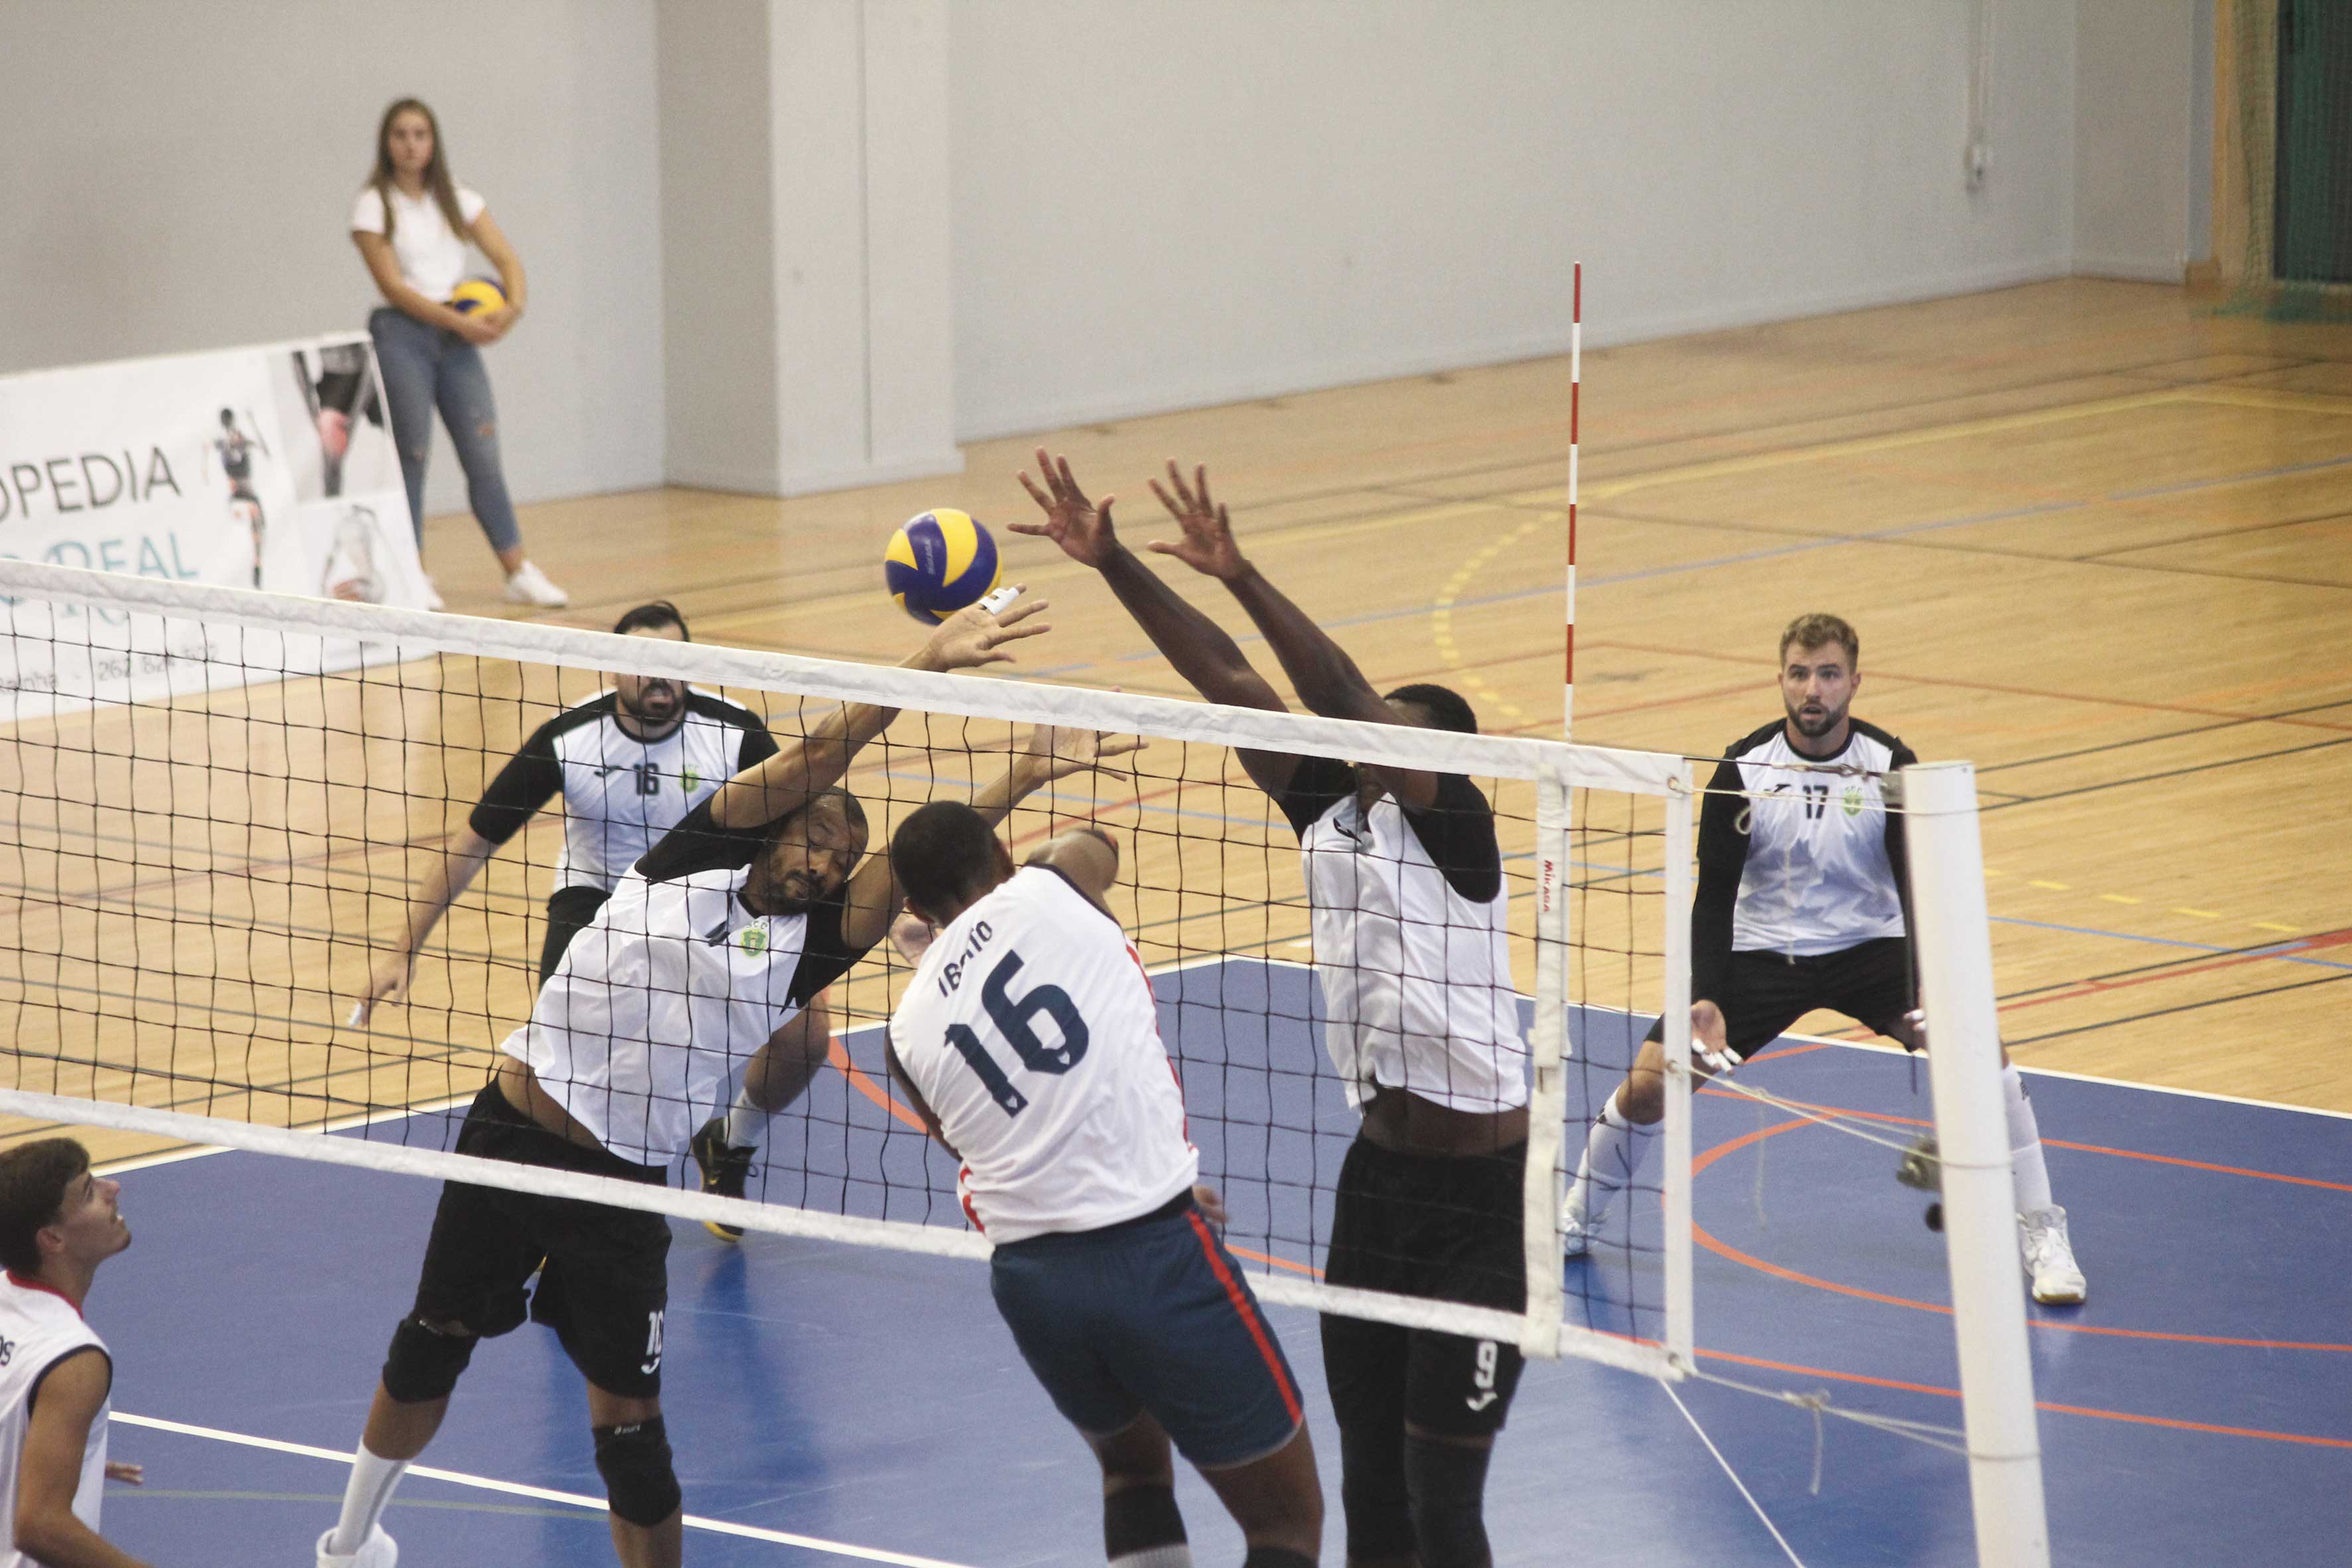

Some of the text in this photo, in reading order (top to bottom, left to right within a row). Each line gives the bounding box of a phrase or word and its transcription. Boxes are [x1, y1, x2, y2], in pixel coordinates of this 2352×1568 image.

[0, 446, 181, 523] PEDIA
[633, 763, 659, 795] 16
[1802, 785, 1829, 820] 17
[944, 949, 1089, 1118] 16
[1474, 1340, 1498, 1389] 9
